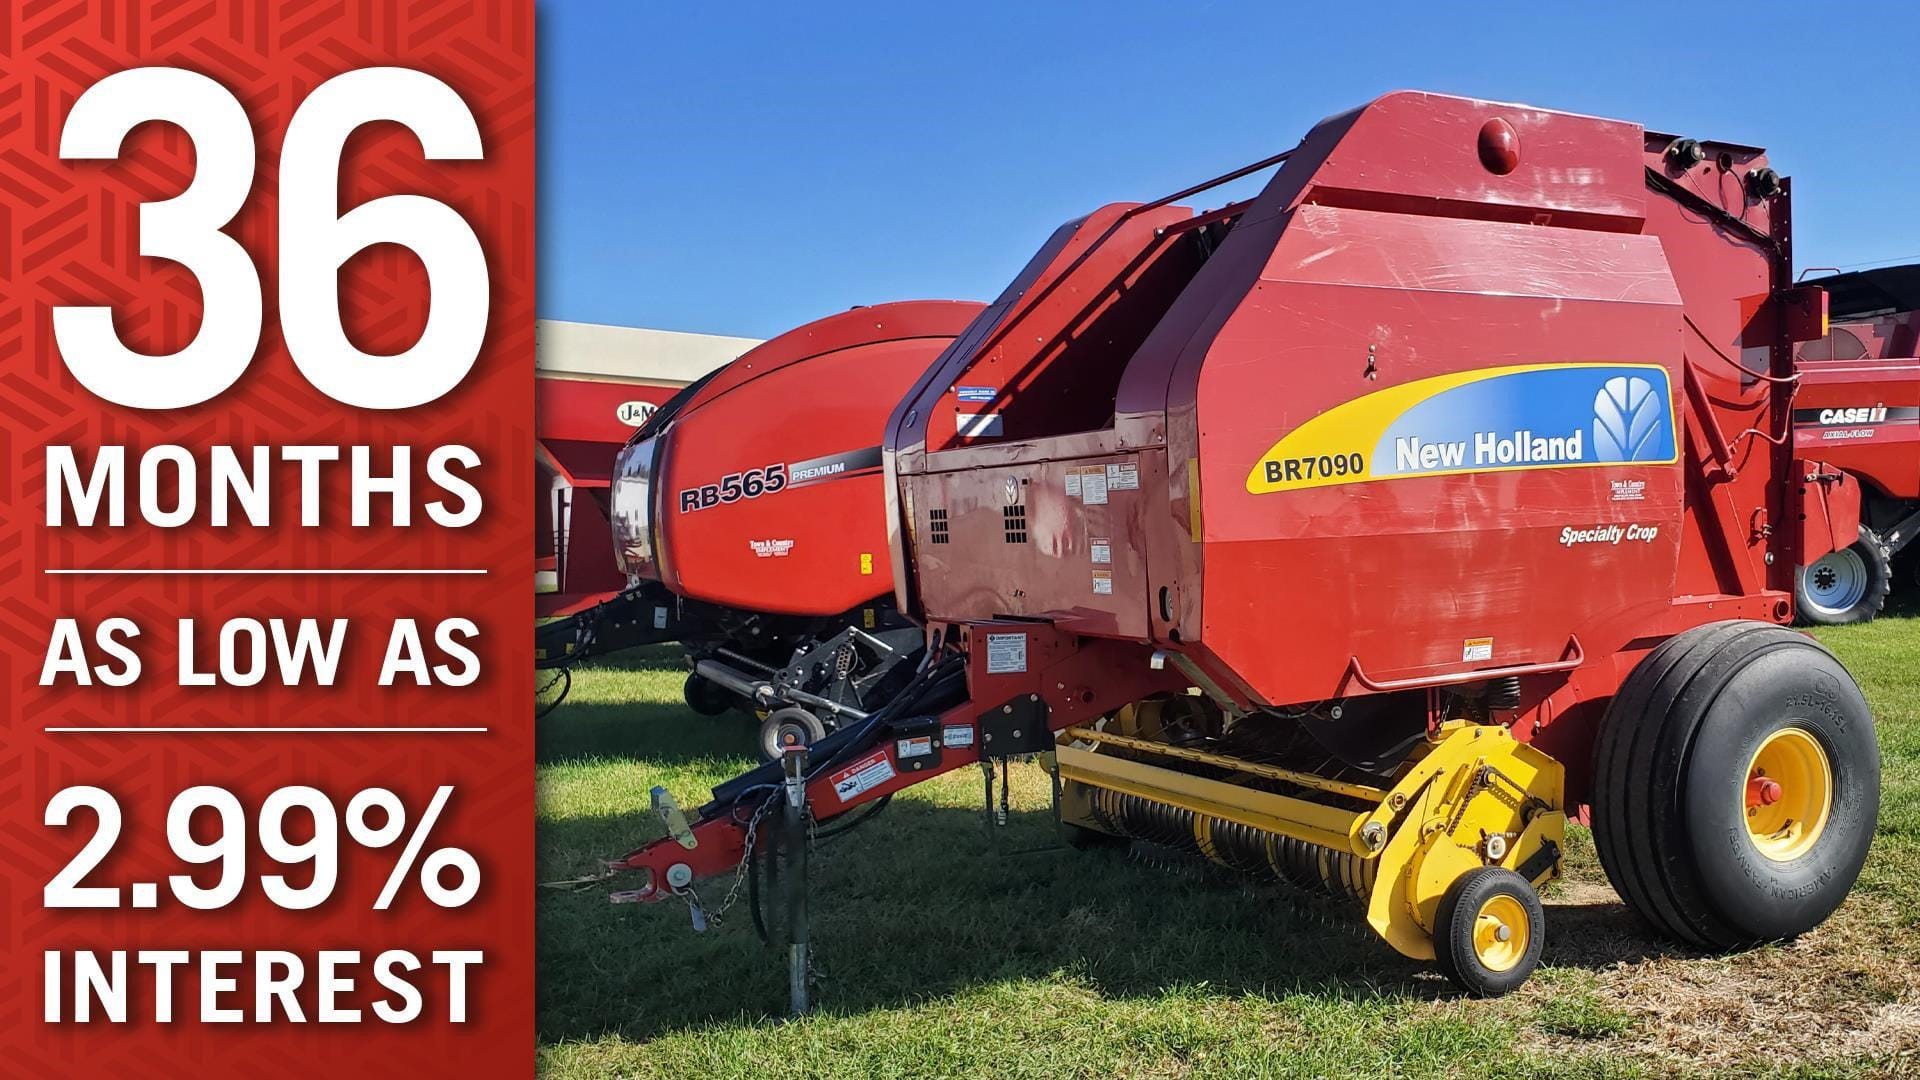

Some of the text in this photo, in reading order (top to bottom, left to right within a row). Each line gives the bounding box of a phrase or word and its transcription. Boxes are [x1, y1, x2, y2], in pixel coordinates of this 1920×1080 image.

[620, 404, 655, 422] J&M
[1396, 429, 1583, 471] New Holland
[792, 462, 845, 481] PREMIUM
[1265, 453, 1364, 483] BR7090
[680, 463, 786, 513] RB565
[1559, 524, 1658, 547] Specialty Crop
[852, 758, 876, 774] DANGER
